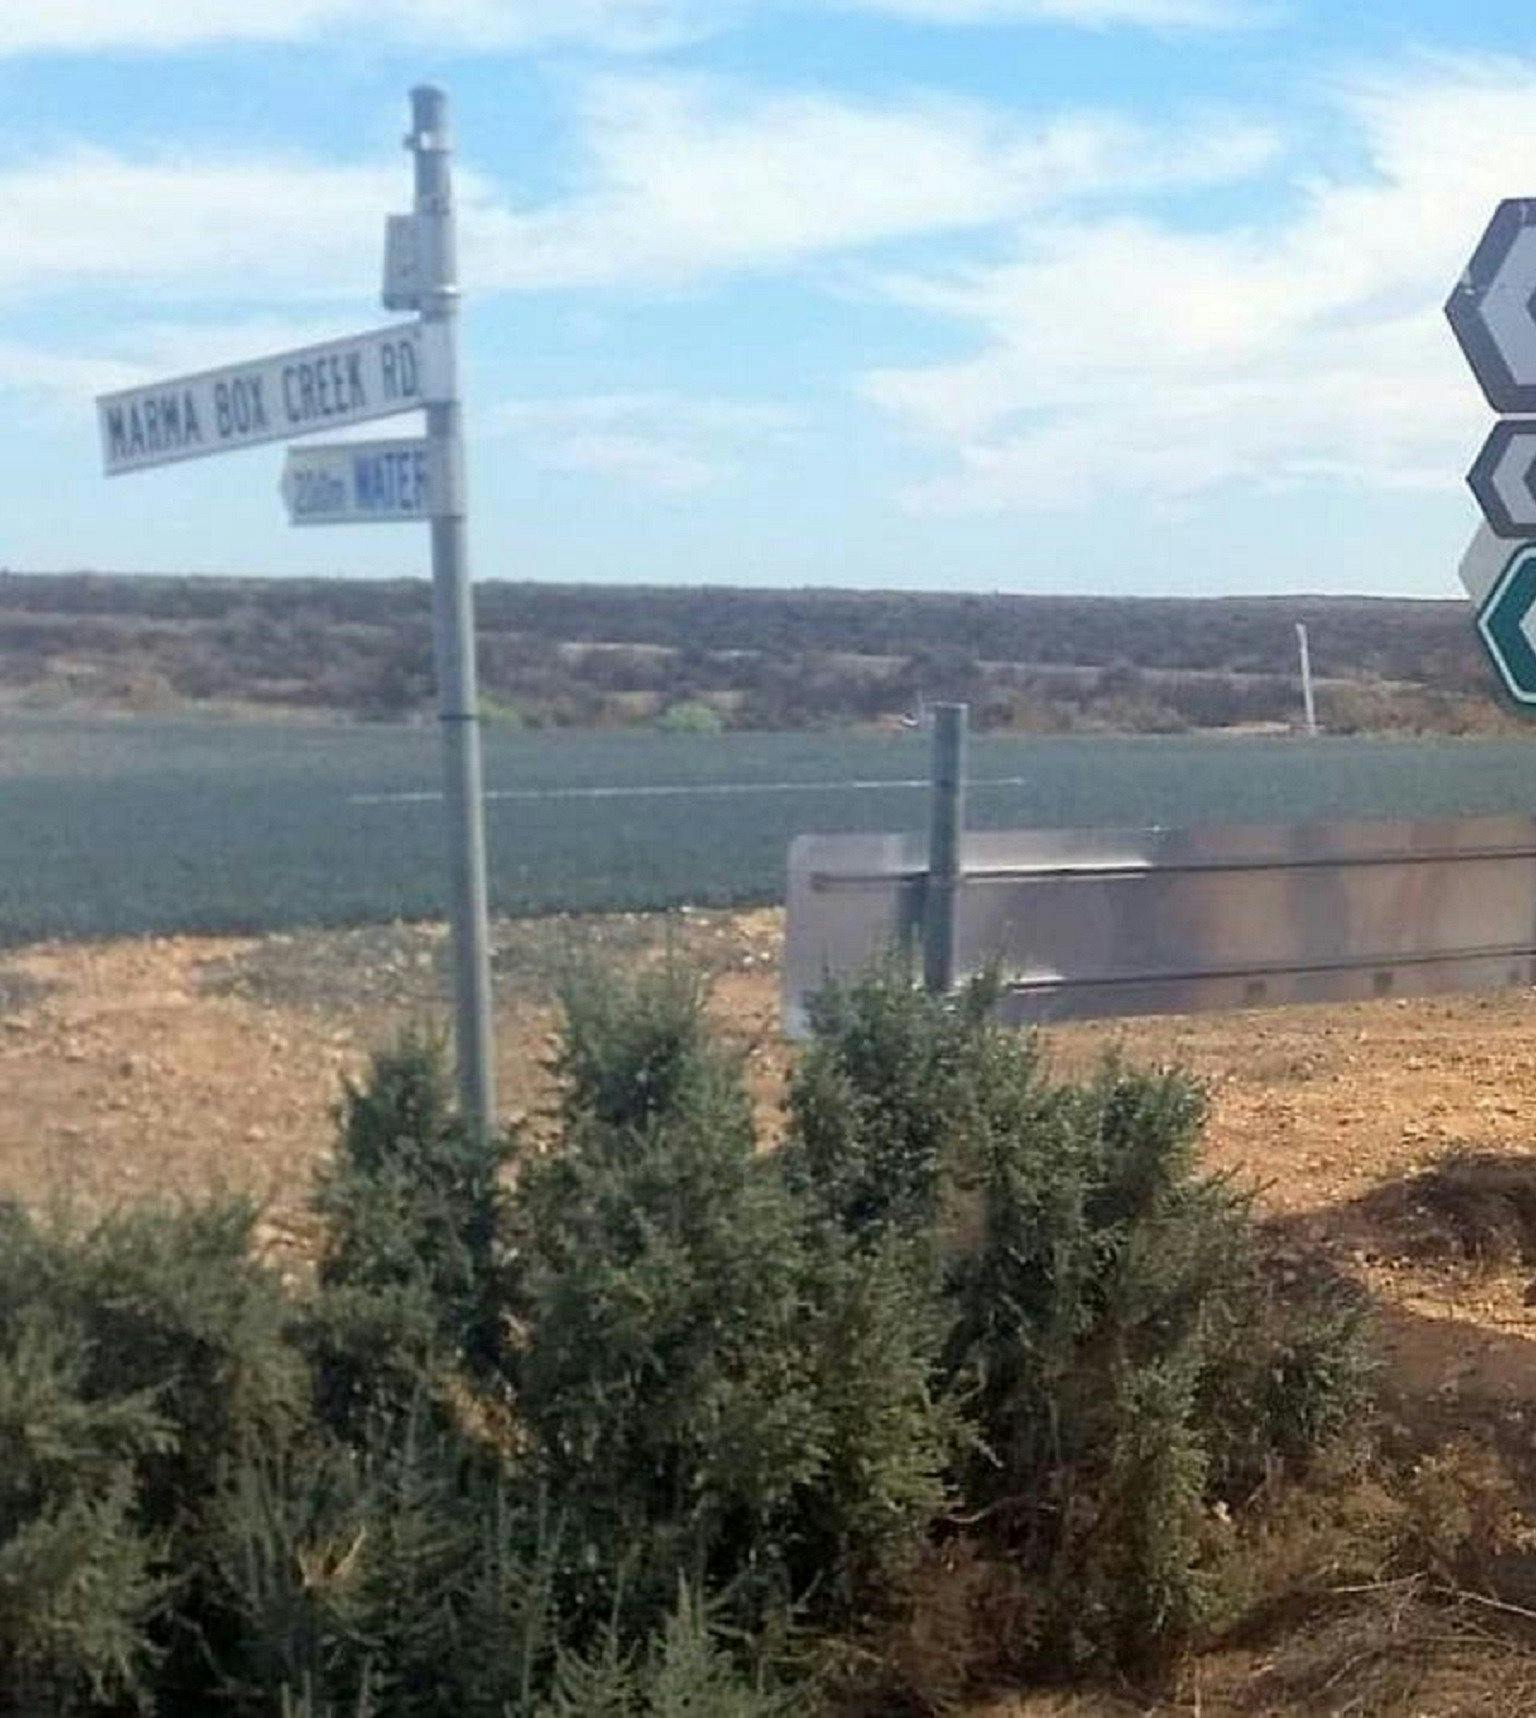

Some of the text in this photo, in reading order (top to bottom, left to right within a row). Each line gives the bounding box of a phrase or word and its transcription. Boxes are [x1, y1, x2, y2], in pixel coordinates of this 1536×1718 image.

[106, 339, 421, 462] MARMA BOX CREEK RD
